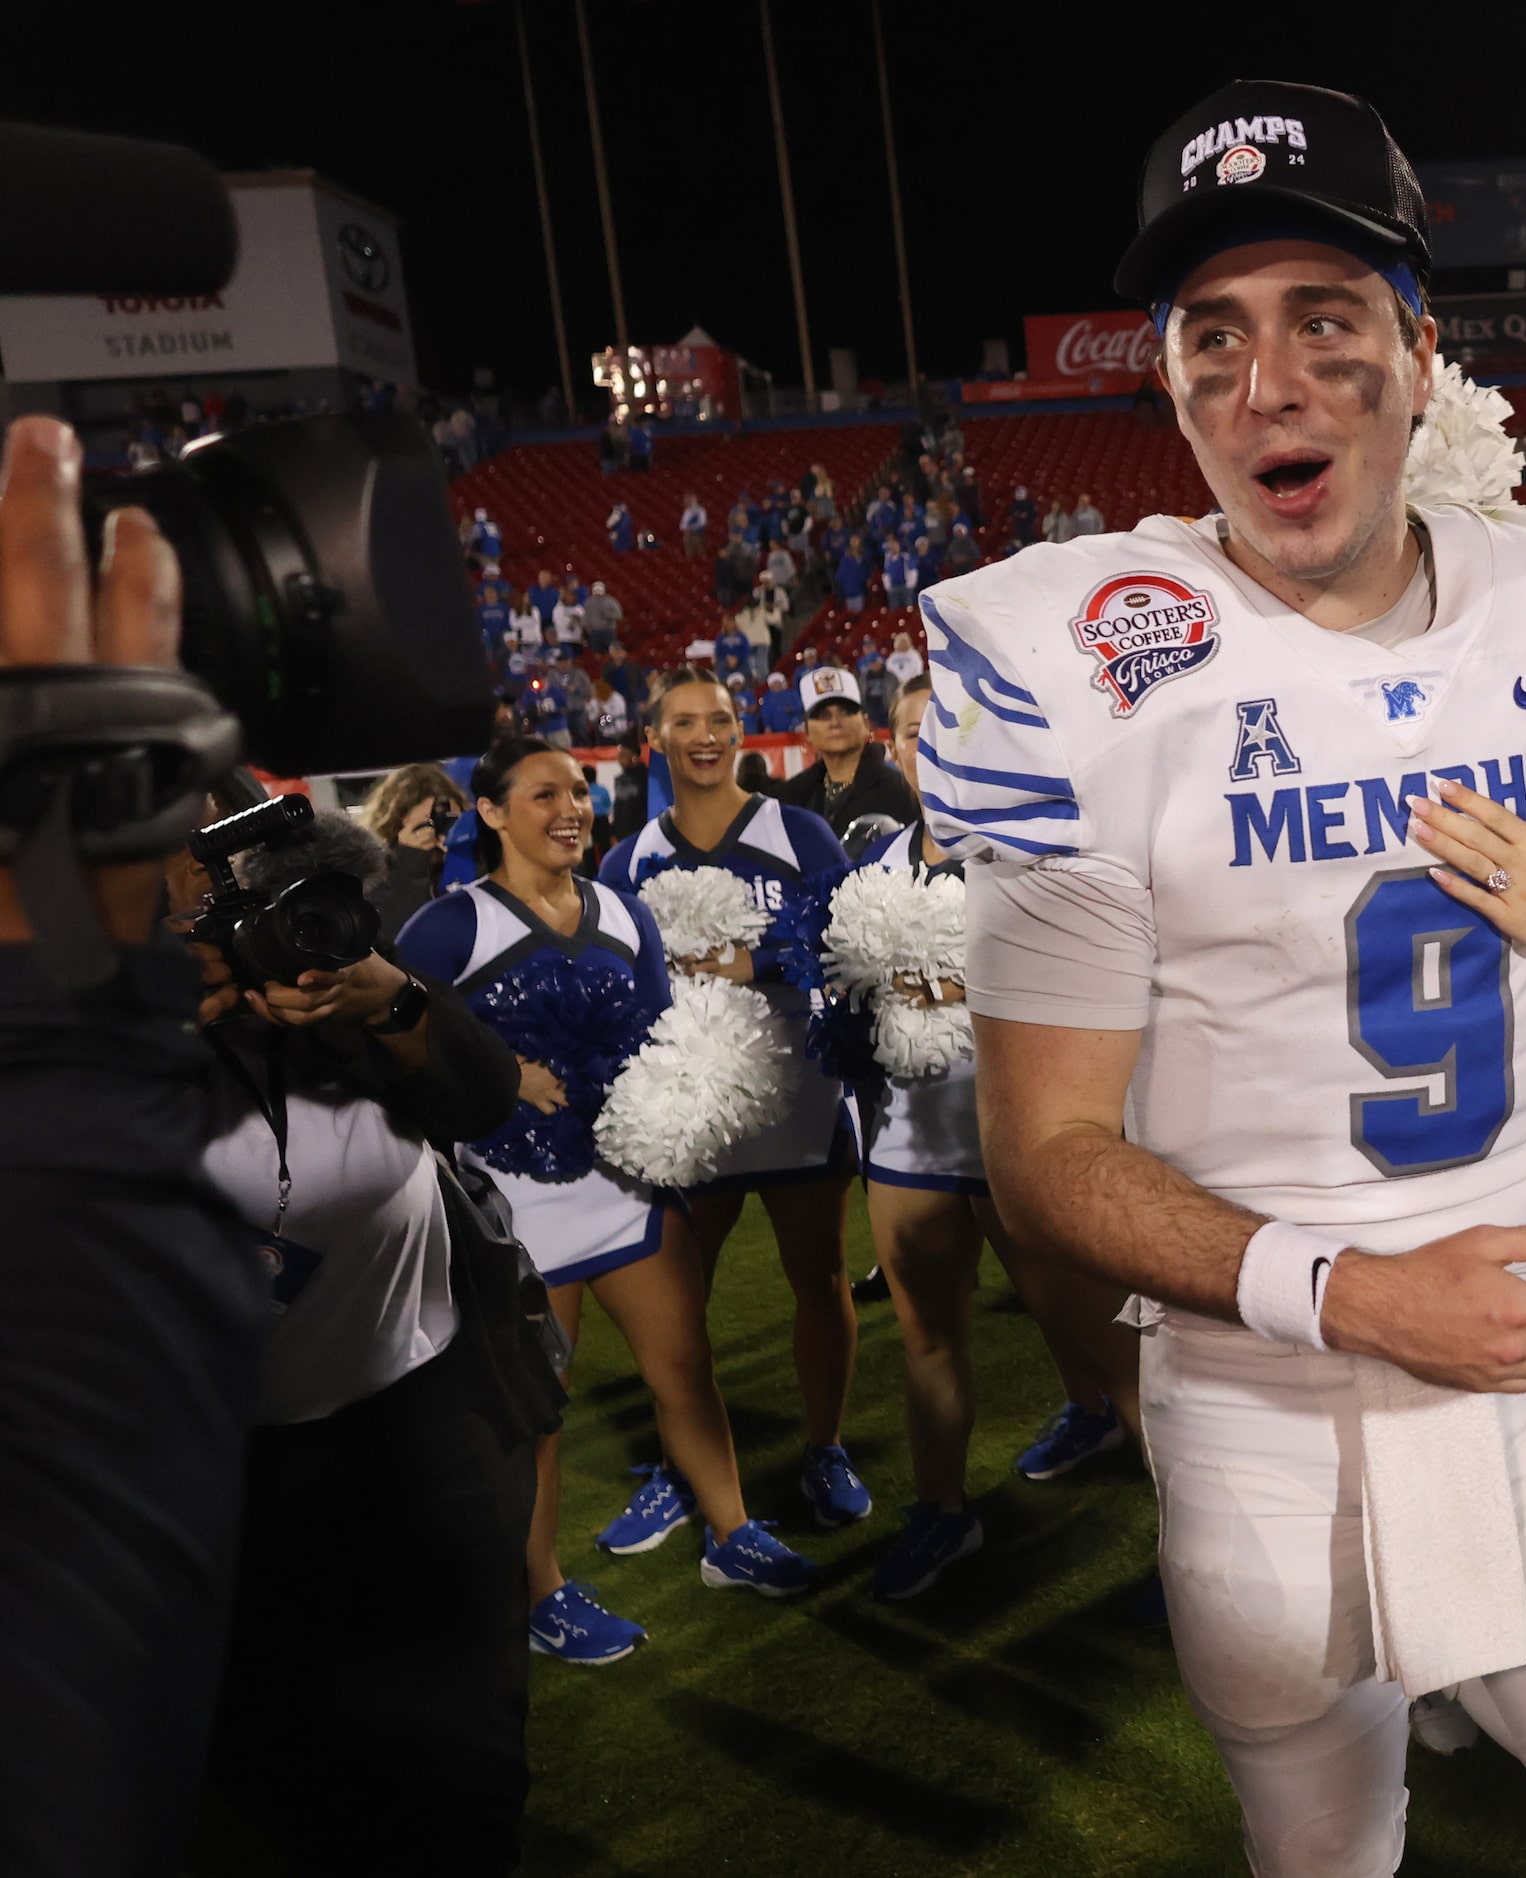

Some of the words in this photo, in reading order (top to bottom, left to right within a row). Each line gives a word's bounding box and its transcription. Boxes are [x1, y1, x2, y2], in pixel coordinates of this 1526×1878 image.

[1181, 116, 1307, 177] CHAMPS
[1288, 154, 1305, 165] 24
[1183, 176, 1197, 192] 20
[105, 331, 234, 357] STADIUM
[1083, 601, 1206, 642] SCOOTER'S
[1118, 626, 1183, 651] COFFEE
[1115, 648, 1195, 692] Frisco
[1343, 863, 1515, 1178] 9
